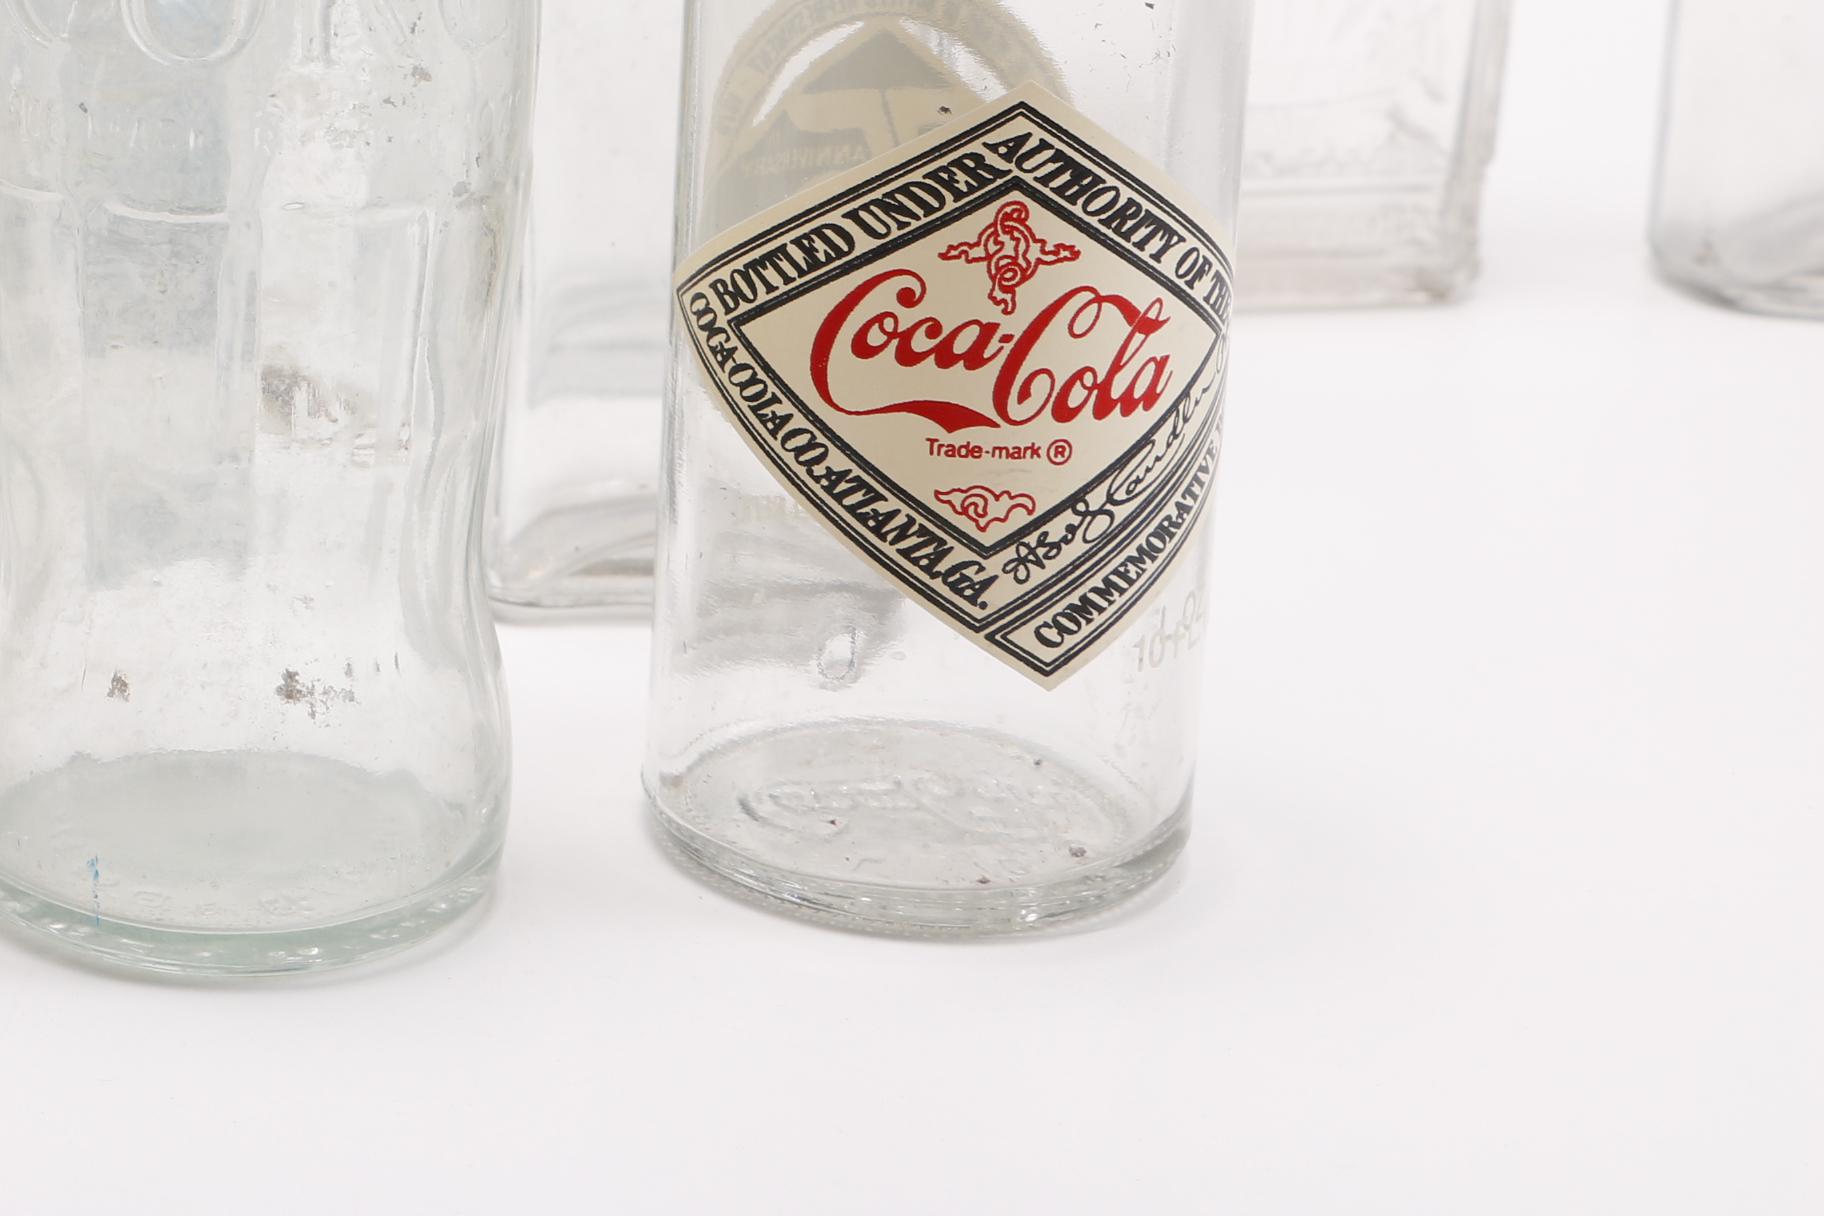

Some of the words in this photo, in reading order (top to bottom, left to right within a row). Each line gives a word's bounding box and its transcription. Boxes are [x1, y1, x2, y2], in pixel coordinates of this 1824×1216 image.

[709, 222, 857, 316] BOTTLED
[842, 150, 1014, 243] UNDER
[981, 131, 1186, 264] AUTHORITY
[1175, 246, 1213, 290] OF
[809, 268, 1174, 434] Coca-Cola
[925, 437, 1042, 461] Trade-mark
[941, 560, 999, 610] GA.
[1033, 439, 1217, 649] COMMEMORATIVE
